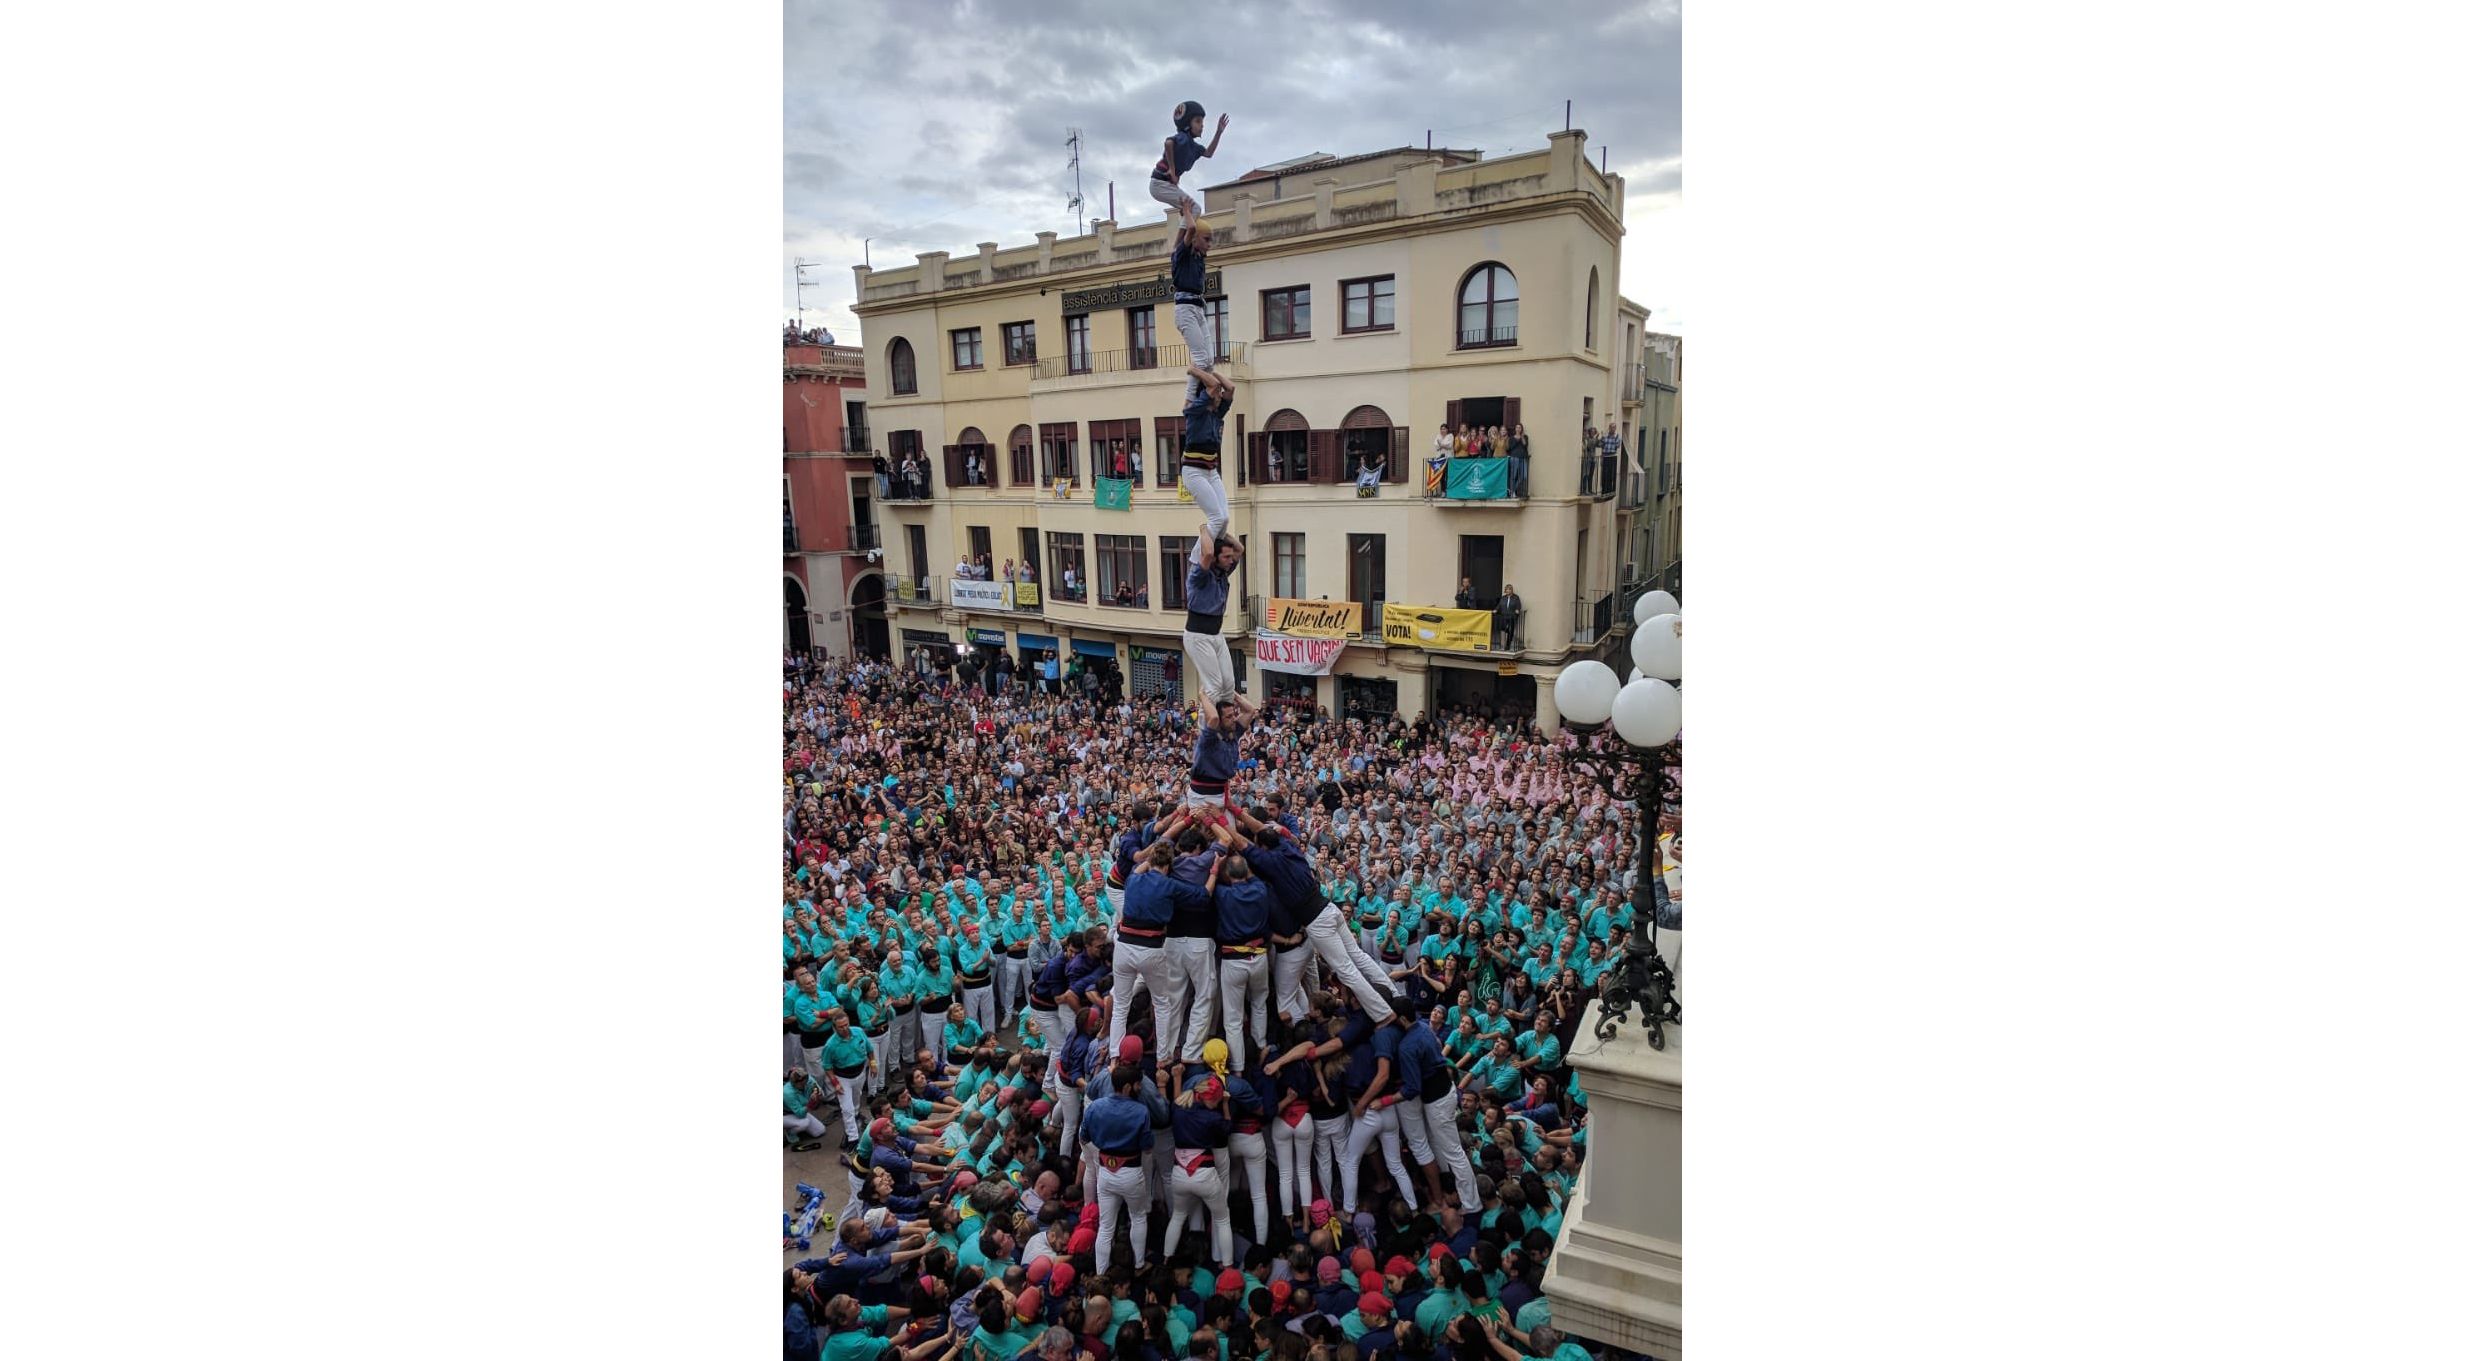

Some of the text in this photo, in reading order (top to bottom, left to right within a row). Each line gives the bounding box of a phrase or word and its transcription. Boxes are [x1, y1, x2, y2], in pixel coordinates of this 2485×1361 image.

[1277, 606, 1350, 631] Llibertat!
[978, 633, 1004, 642] movistar
[1386, 624, 1411, 639] VOTA!
[1258, 640, 1281, 662] QUE
